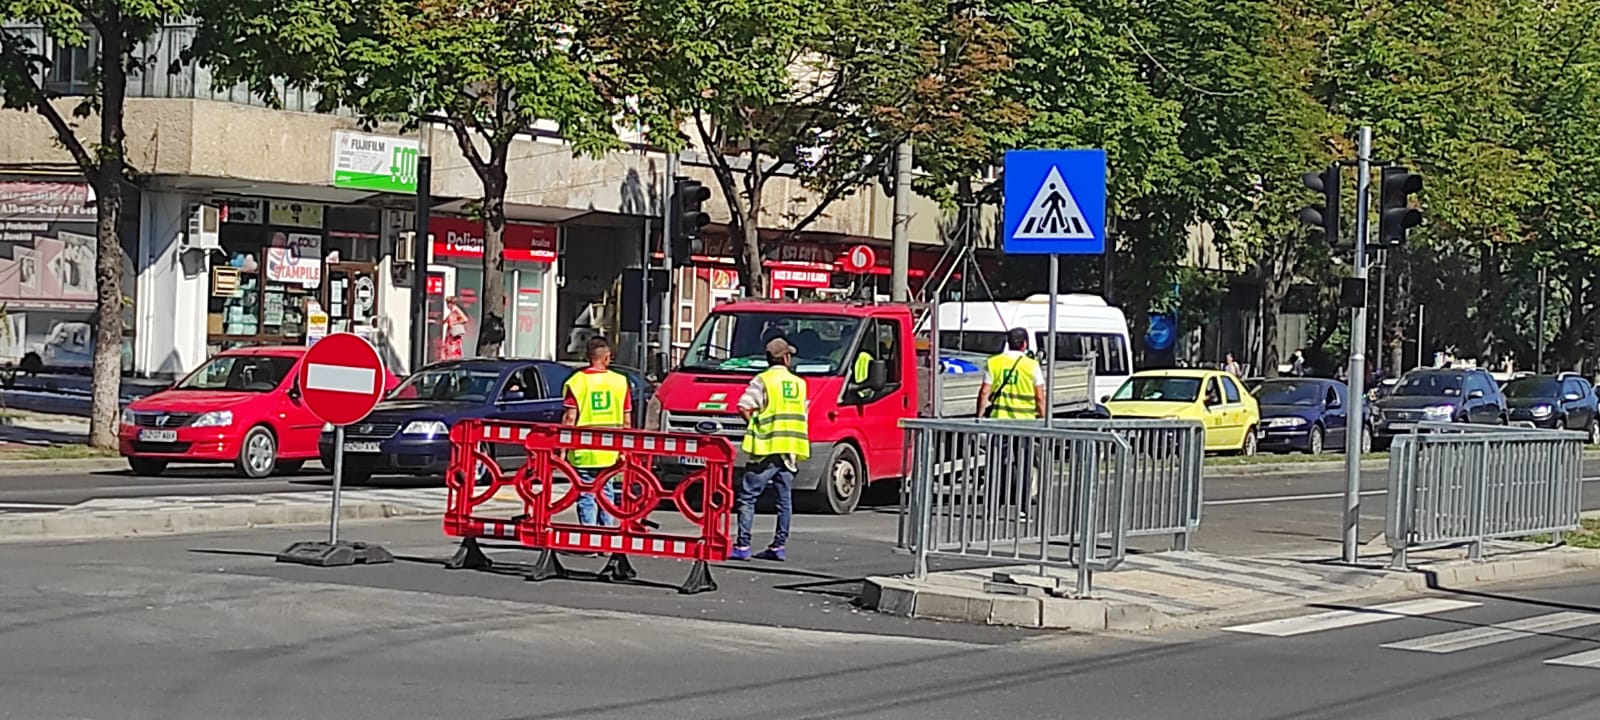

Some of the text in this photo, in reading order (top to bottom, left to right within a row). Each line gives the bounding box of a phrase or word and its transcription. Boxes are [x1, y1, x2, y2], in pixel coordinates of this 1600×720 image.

[351, 138, 386, 153] FUJIFILM
[390, 146, 418, 185] FOT
[447, 231, 484, 252] Polian
